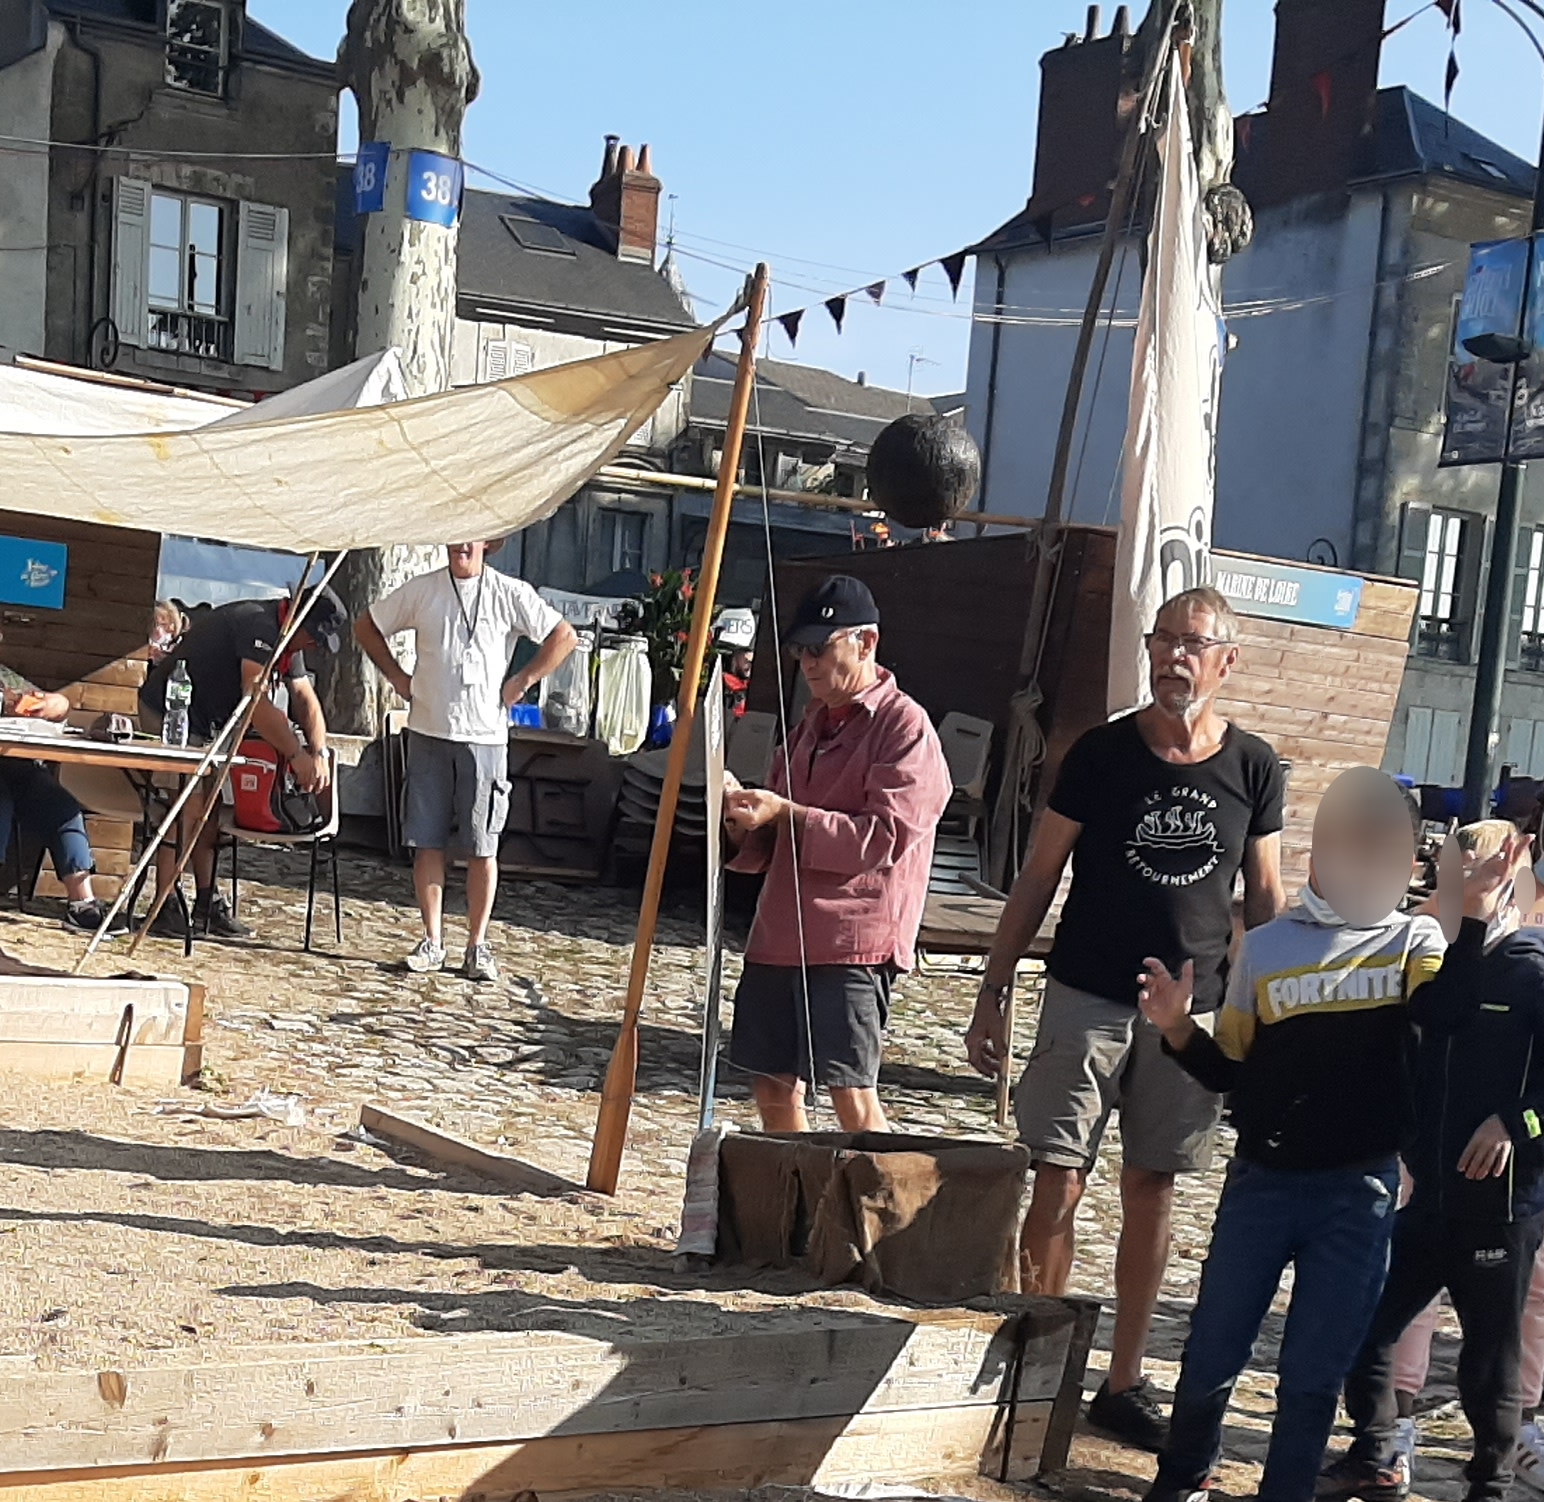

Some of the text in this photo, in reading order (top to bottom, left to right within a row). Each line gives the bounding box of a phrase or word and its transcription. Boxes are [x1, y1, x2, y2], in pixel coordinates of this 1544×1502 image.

[420, 171, 452, 205] 38
[1216, 570, 1301, 606] MARINE DE LOIRE
[1144, 786, 1217, 808] LE GRAND
[1125, 848, 1219, 886] RETOURNEMENT
[1267, 962, 1404, 1018] FORTNITE
